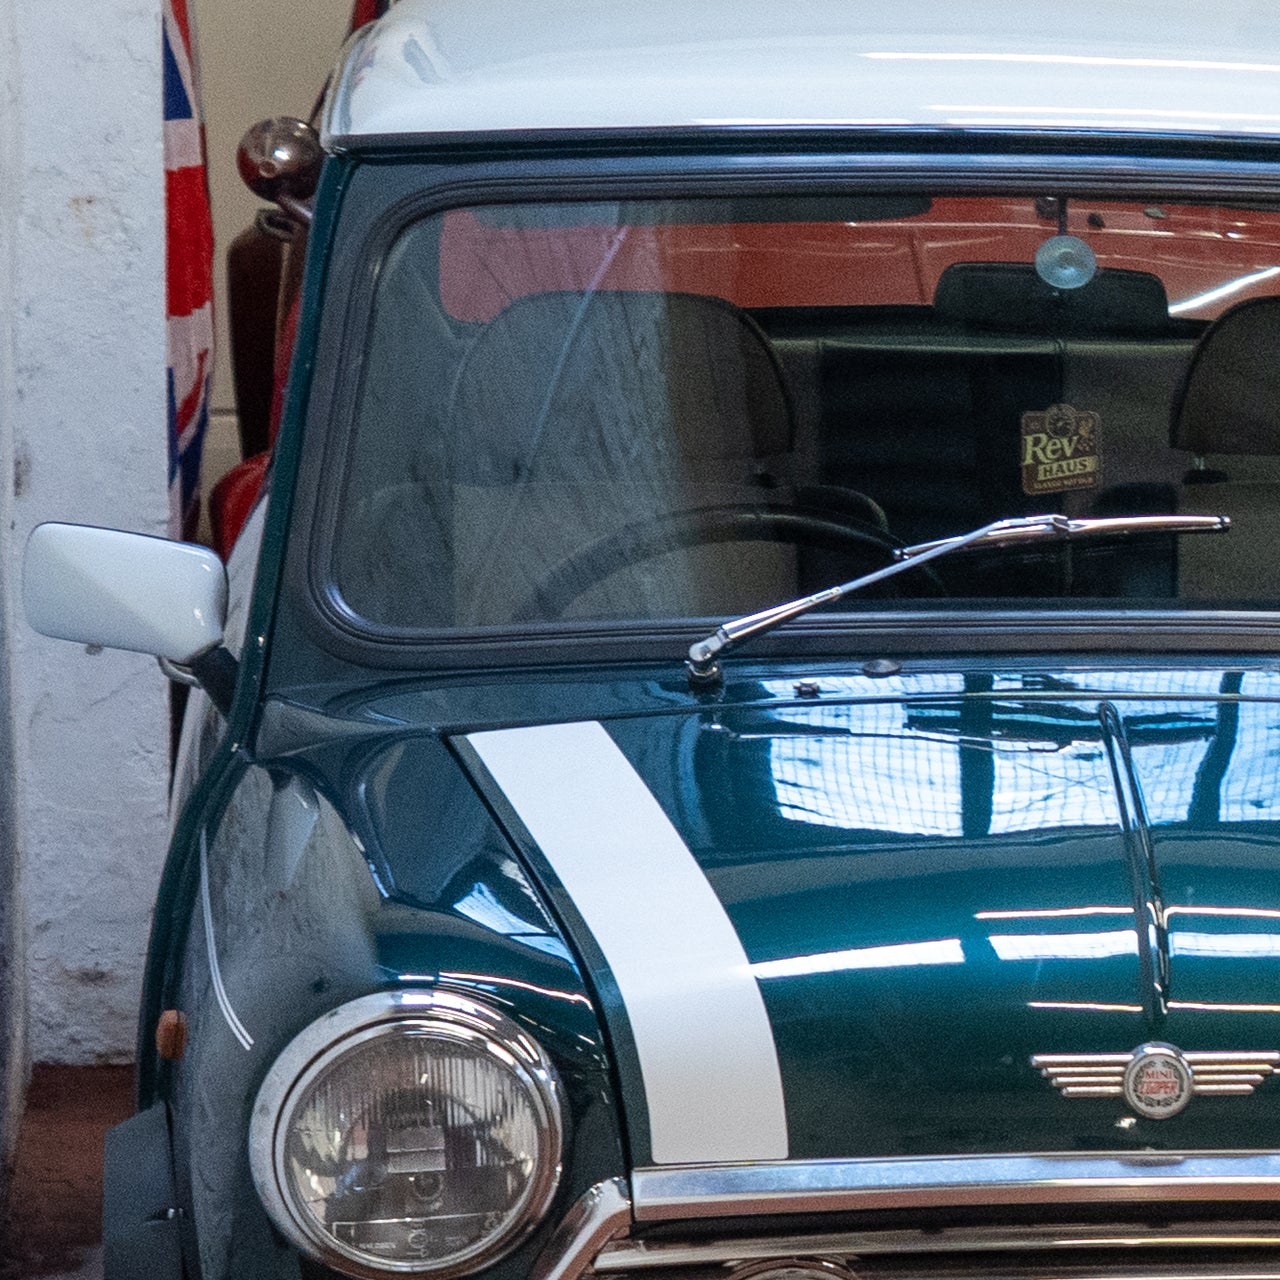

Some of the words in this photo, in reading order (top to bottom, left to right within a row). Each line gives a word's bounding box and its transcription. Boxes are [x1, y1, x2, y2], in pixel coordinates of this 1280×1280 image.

[1020, 433, 1079, 466] Rev
[1043, 459, 1088, 478] HAUS
[1145, 1070, 1173, 1080] MINI
